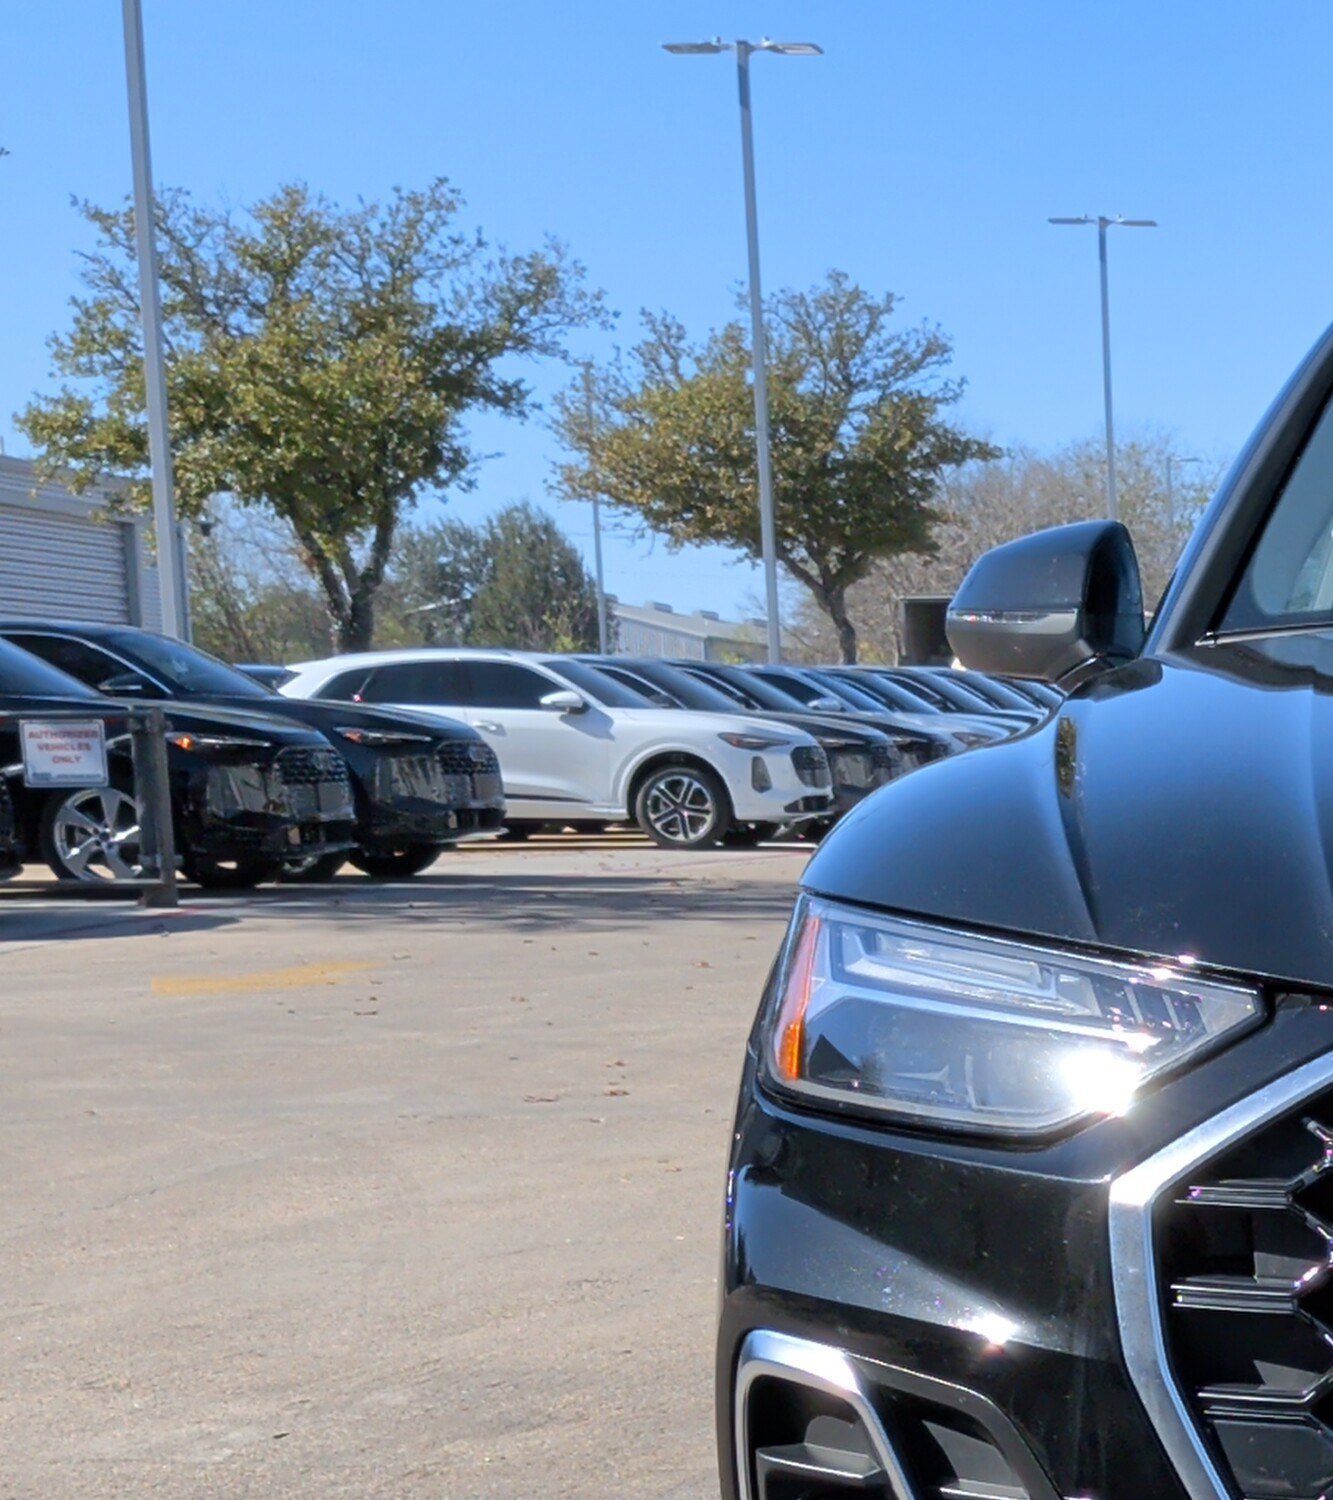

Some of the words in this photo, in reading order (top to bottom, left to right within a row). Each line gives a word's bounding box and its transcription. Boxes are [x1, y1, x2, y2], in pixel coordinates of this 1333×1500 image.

[28, 730, 98, 739] AUTHORIZED
[37, 742, 92, 751] VEHICLES
[52, 755, 81, 764] ONLY
